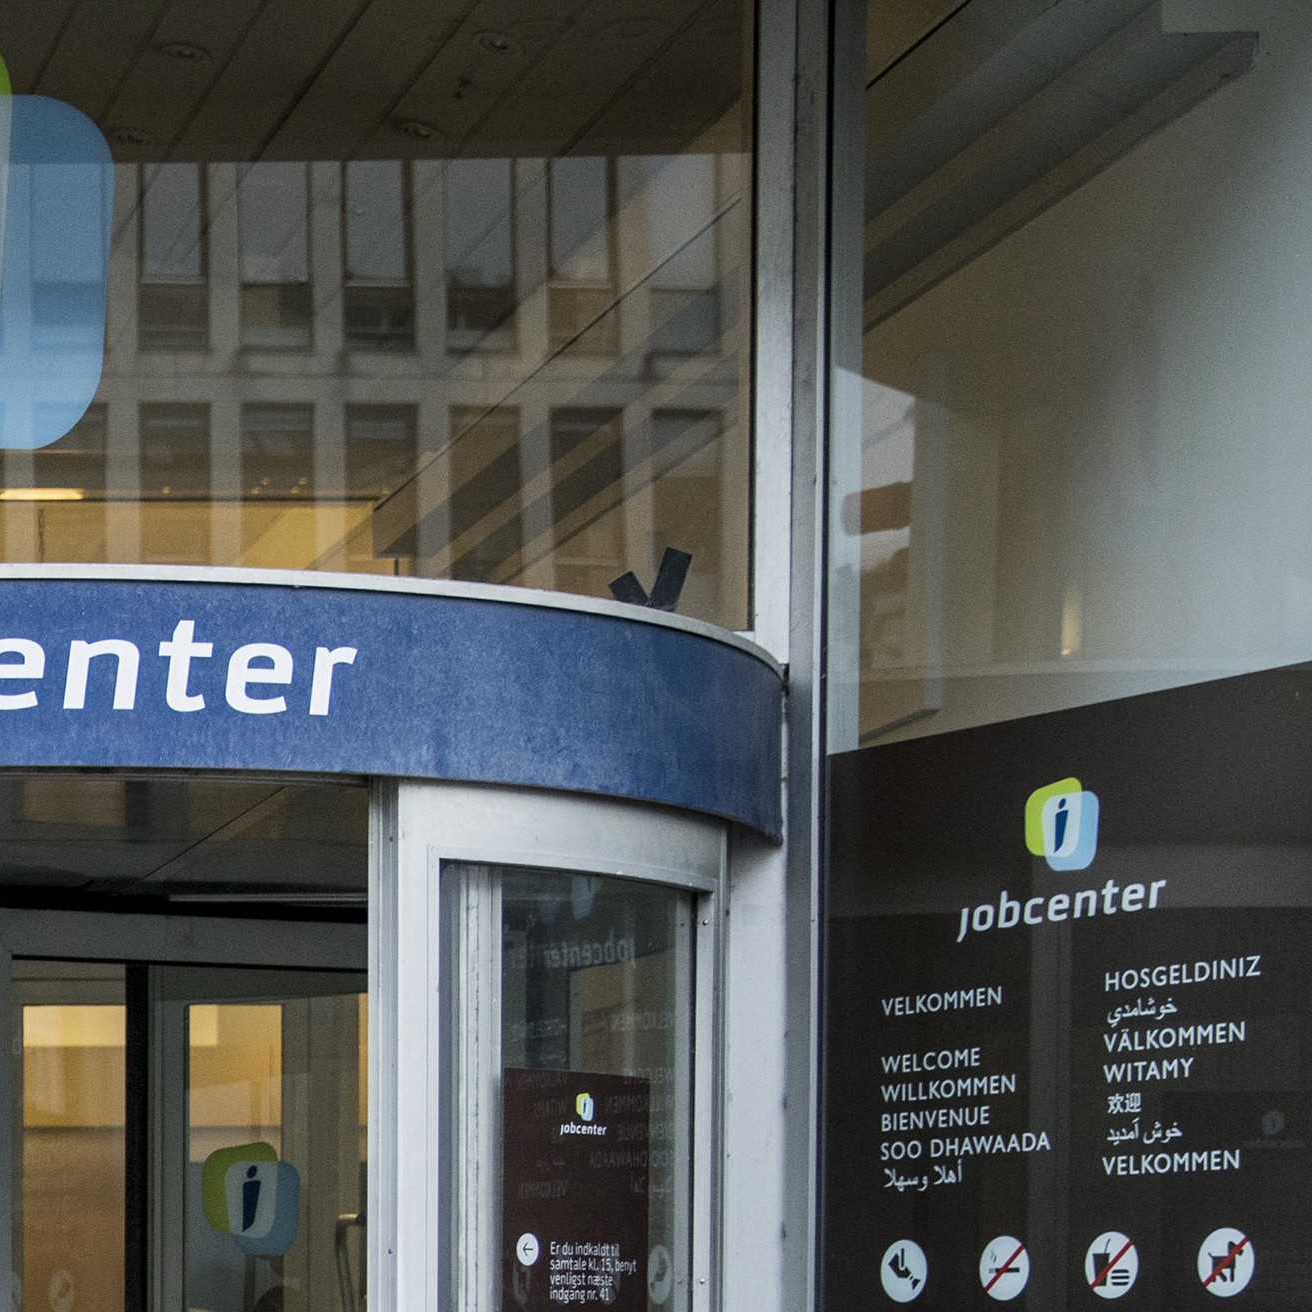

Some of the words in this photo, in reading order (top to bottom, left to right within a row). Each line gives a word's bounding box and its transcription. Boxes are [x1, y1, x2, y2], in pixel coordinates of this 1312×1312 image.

[957, 879, 1167, 942] jobcenter
[882, 986, 1001, 1016] VELKOMMEN
[1104, 1018, 1245, 1052] VÄLKOMMEN
[881, 1048, 980, 1073] WELCOME
[1103, 1057, 1194, 1082] WITAMY
[881, 1074, 1015, 1102] WILLKOMMEN
[1108, 1093, 1141, 1114] 欢迎
[560, 1120, 607, 1137] jobcenter
[882, 1106, 990, 1131] BIENVENUE
[881, 1141, 921, 1160] SOO
[931, 1132, 1051, 1157] DHAWAADA
[1102, 1150, 1239, 1175] VELKOMMEN
[550, 1242, 560, 1254] Er
[562, 1242, 573, 1255] du
[575, 1242, 610, 1256] indkaldt
[611, 1243, 619, 1257] til
[550, 1258, 586, 1270] samtale
[588, 1258, 599, 1270] kl.
[601, 1259, 613, 1273] 15,
[615, 1259, 637, 1275] benyt
[550, 1272, 585, 1288] venligst
[588, 1274, 613, 1286] næste
[550, 1287, 585, 1303] indgang
[587, 1290, 598, 1300] nr.
[599, 1288, 609, 1300] 41
